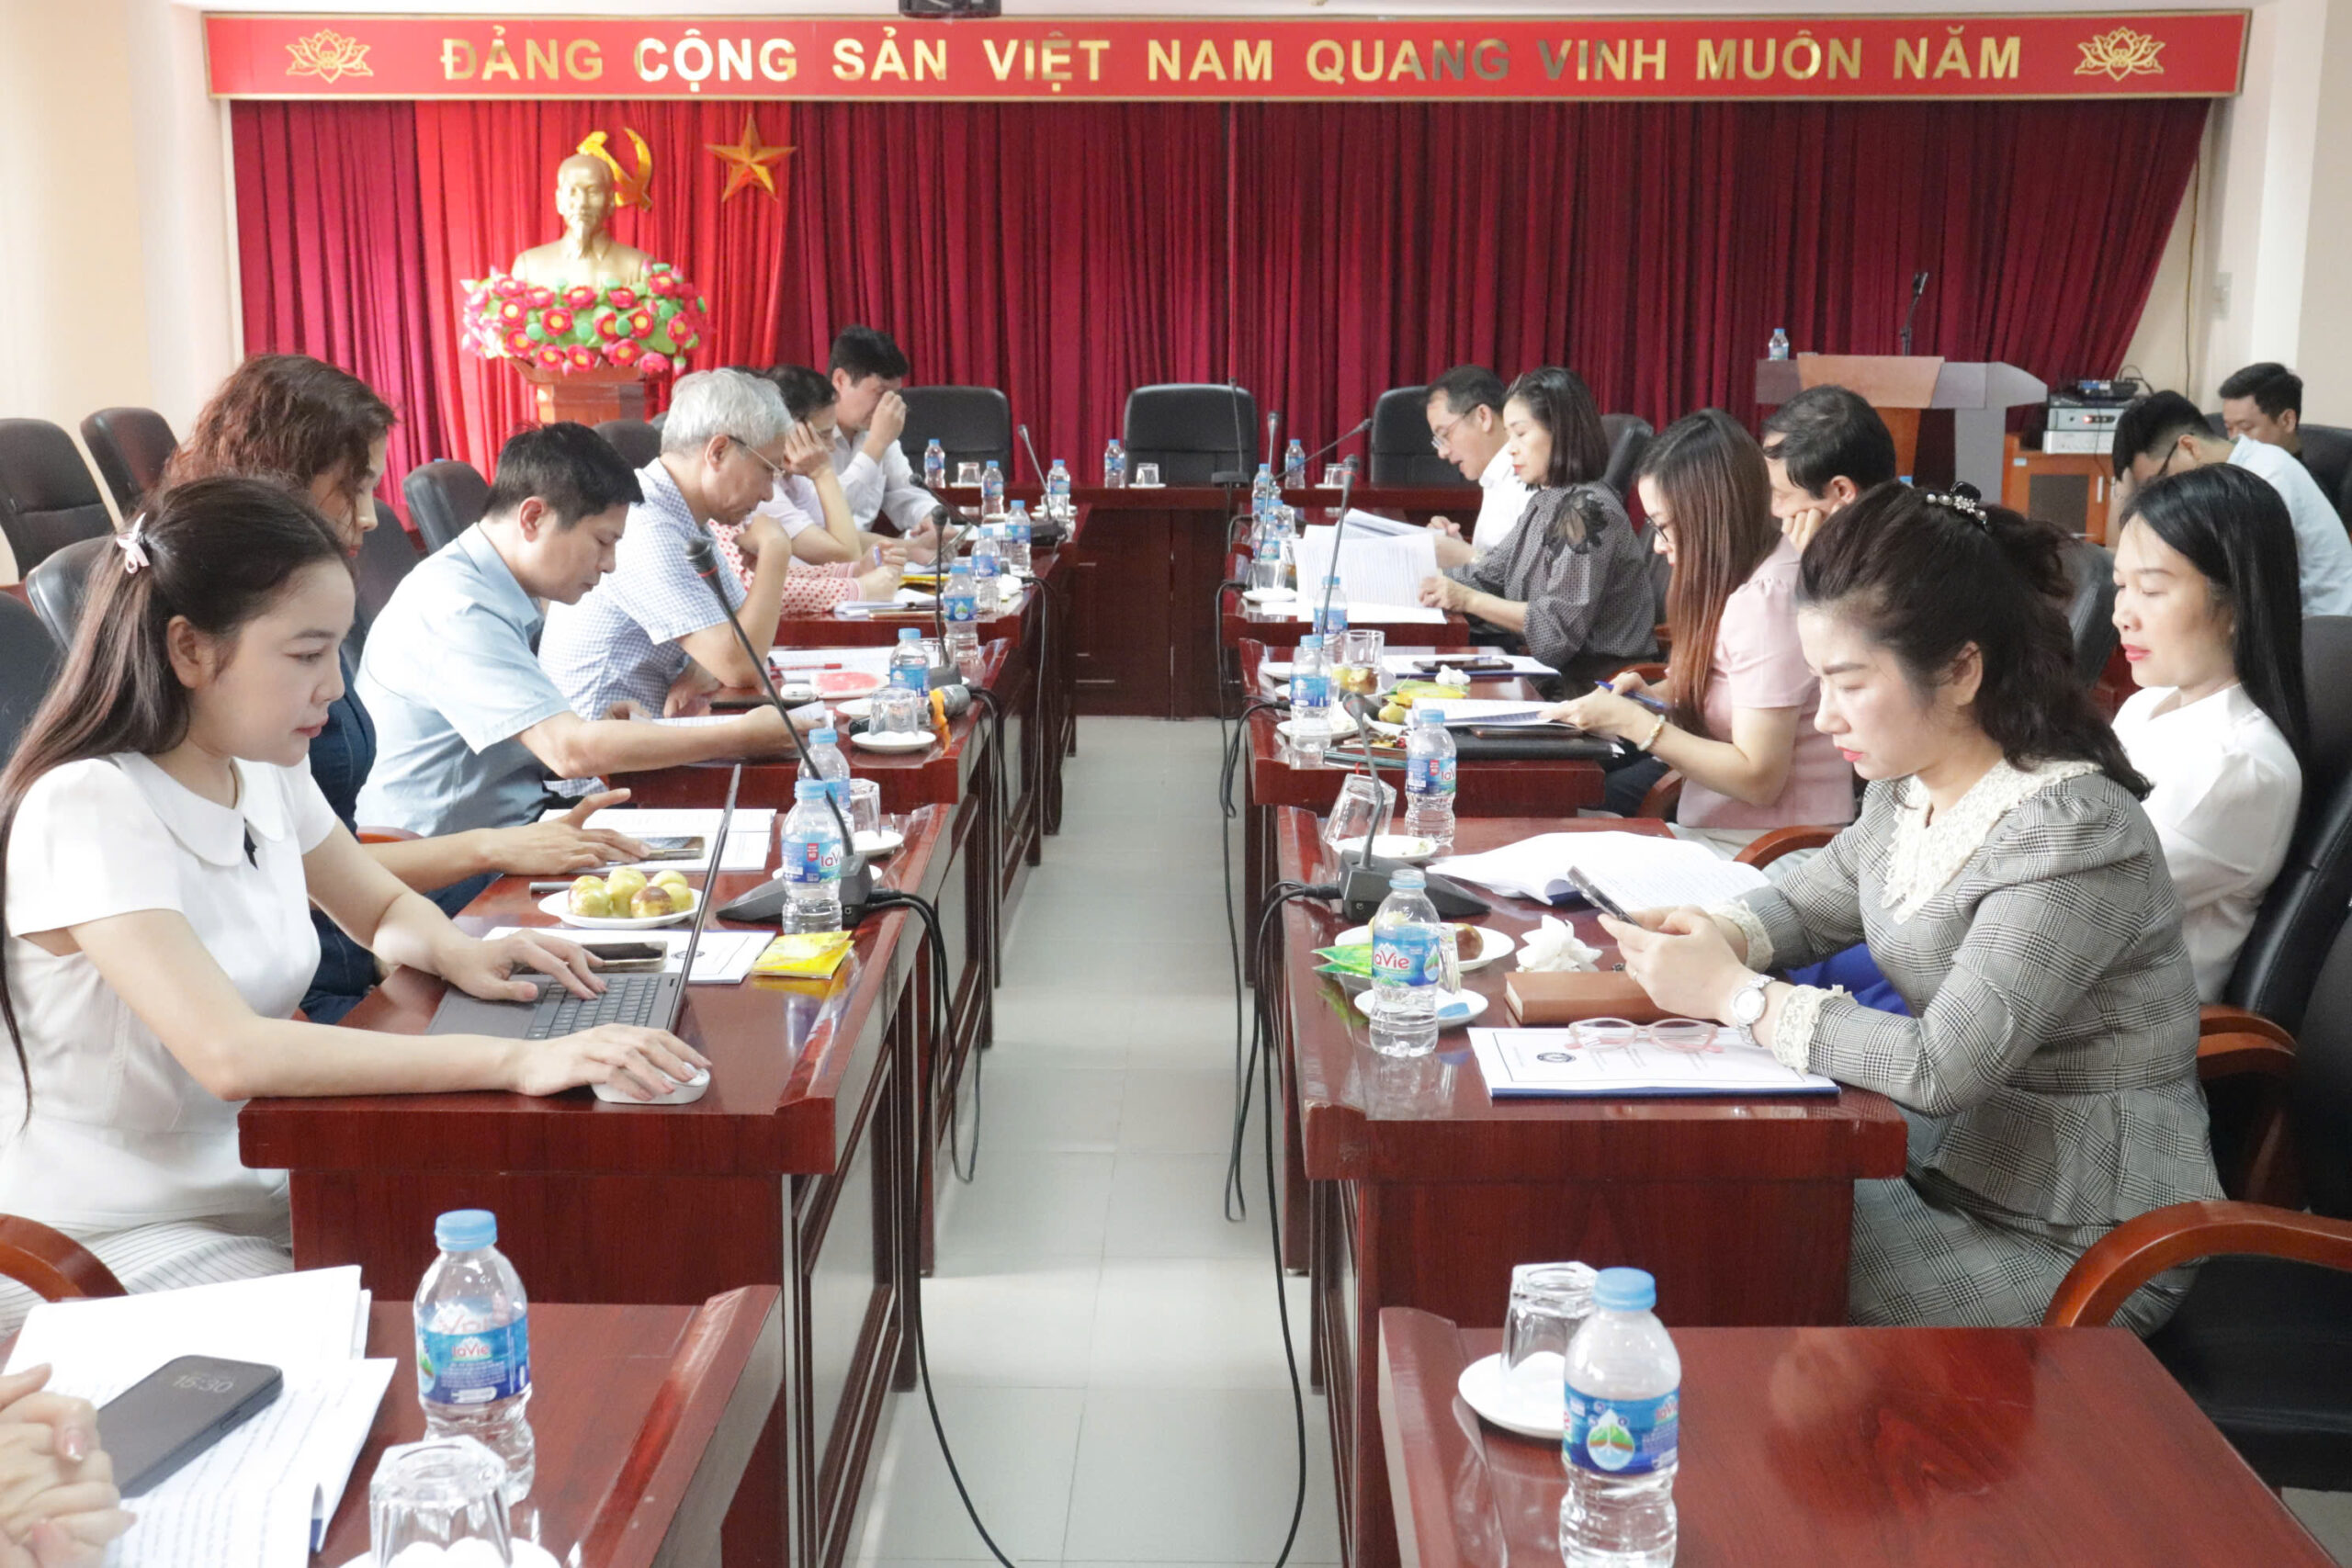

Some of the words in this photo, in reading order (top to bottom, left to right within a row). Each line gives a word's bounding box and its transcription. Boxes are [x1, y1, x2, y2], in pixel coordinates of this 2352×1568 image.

[440, 25, 603, 82] ĐẢNG
[633, 28, 797, 93] CỘNG
[831, 26, 947, 82] SẢN
[982, 30, 1112, 93] VIỆT
[1148, 39, 1273, 82] NAM
[1306, 39, 1510, 85] QUANG
[1537, 39, 1667, 82] VINH
[1696, 29, 1863, 82] MUÔN
[1893, 24, 2021, 81] NĂM
[820, 852, 840, 867] laV
[1374, 950, 1409, 970] aVie
[452, 1342, 490, 1358] laVie
